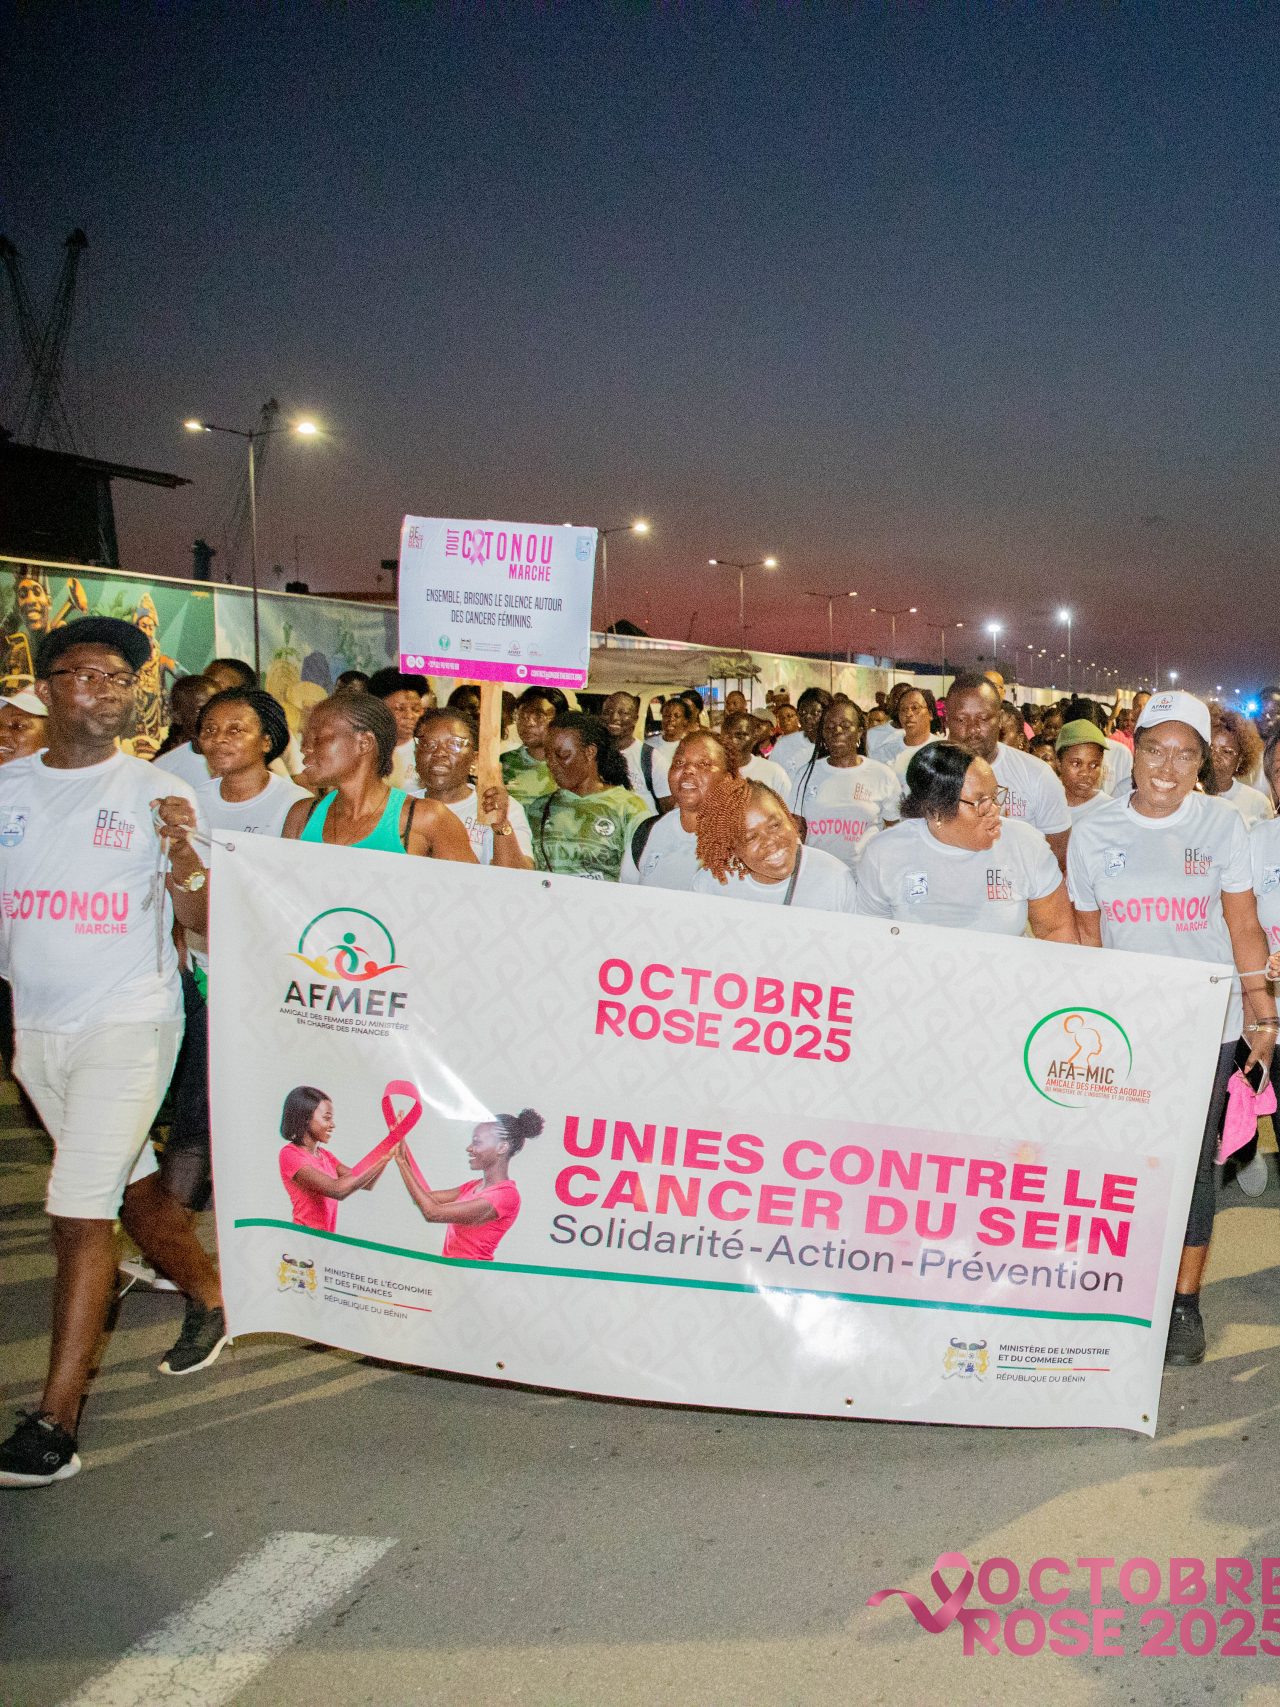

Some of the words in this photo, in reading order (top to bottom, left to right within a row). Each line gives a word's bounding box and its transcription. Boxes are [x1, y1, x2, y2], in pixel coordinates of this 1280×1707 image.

[446, 529, 460, 557] TOUT
[509, 564, 551, 582] MARCHE
[426, 588, 462, 605] ENSEMBLE,
[464, 591, 493, 607] BRISONS
[494, 594, 503, 607] LE
[504, 595, 533, 610] SILENCE
[534, 597, 562, 611] AUTOUR
[451, 610, 464, 623] DES
[465, 611, 496, 626] CANCERS
[498, 610, 533, 629] FÉMININS.
[96, 809, 120, 830] BE
[118, 820, 136, 833] the
[93, 828, 134, 849] BEST
[1185, 848, 1200, 862] BE
[986, 869, 1002, 886] BE
[1111, 895, 1211, 923] COTONOU
[74, 923, 128, 935] MARCHE
[1175, 920, 1208, 933] MARCHE
[284, 980, 409, 1018] AFMEF
[598, 958, 855, 1024] OCTOBRE
[279, 1007, 309, 1018] AMICALE
[310, 1012, 323, 1021] DES
[324, 1015, 353, 1026] FEMMES
[355, 1019, 367, 1027] DU
[307, 1020, 335, 1031] CHARGE
[336, 1025, 350, 1033] DES
[351, 1027, 390, 1037] FINANCES
[595, 999, 723, 1049] ROSE
[732, 1016, 852, 1063] 2025
[1047, 1059, 1115, 1085] AFA-MIC
[1045, 1078, 1075, 1089] AMICALE
[1076, 1082, 1089, 1091] DES
[1090, 1083, 1118, 1094] FEMMES
[563, 1115, 765, 1175] UNIES
[783, 1139, 1048, 1203] CONTRE
[1063, 1168, 1138, 1214] LE
[554, 1164, 844, 1231] CANCER
[864, 1194, 957, 1241] DU
[976, 1206, 1131, 1258] SEIN
[324, 1275, 334, 1283] ET
[335, 1277, 351, 1289] DES
[352, 1281, 393, 1298] FINANCES
[367, 1275, 379, 1286] DE
[324, 1294, 369, 1313] RÉPUBLIQUE
[370, 1305, 383, 1315] DU
[384, 1306, 408, 1320] BÉNIN
[998, 1354, 1009, 1362] ET
[1010, 1354, 1023, 1363] DU
[1024, 1354, 1074, 1364] COMMERCE
[1047, 1346, 1059, 1355] DE
[1060, 1347, 1111, 1356] L'INDUSTRIE
[996, 1372, 1048, 1385] RÉPUBLIQUE
[1048, 1374, 1061, 1383] DU
[1062, 1373, 1086, 1383] BÉNIN
